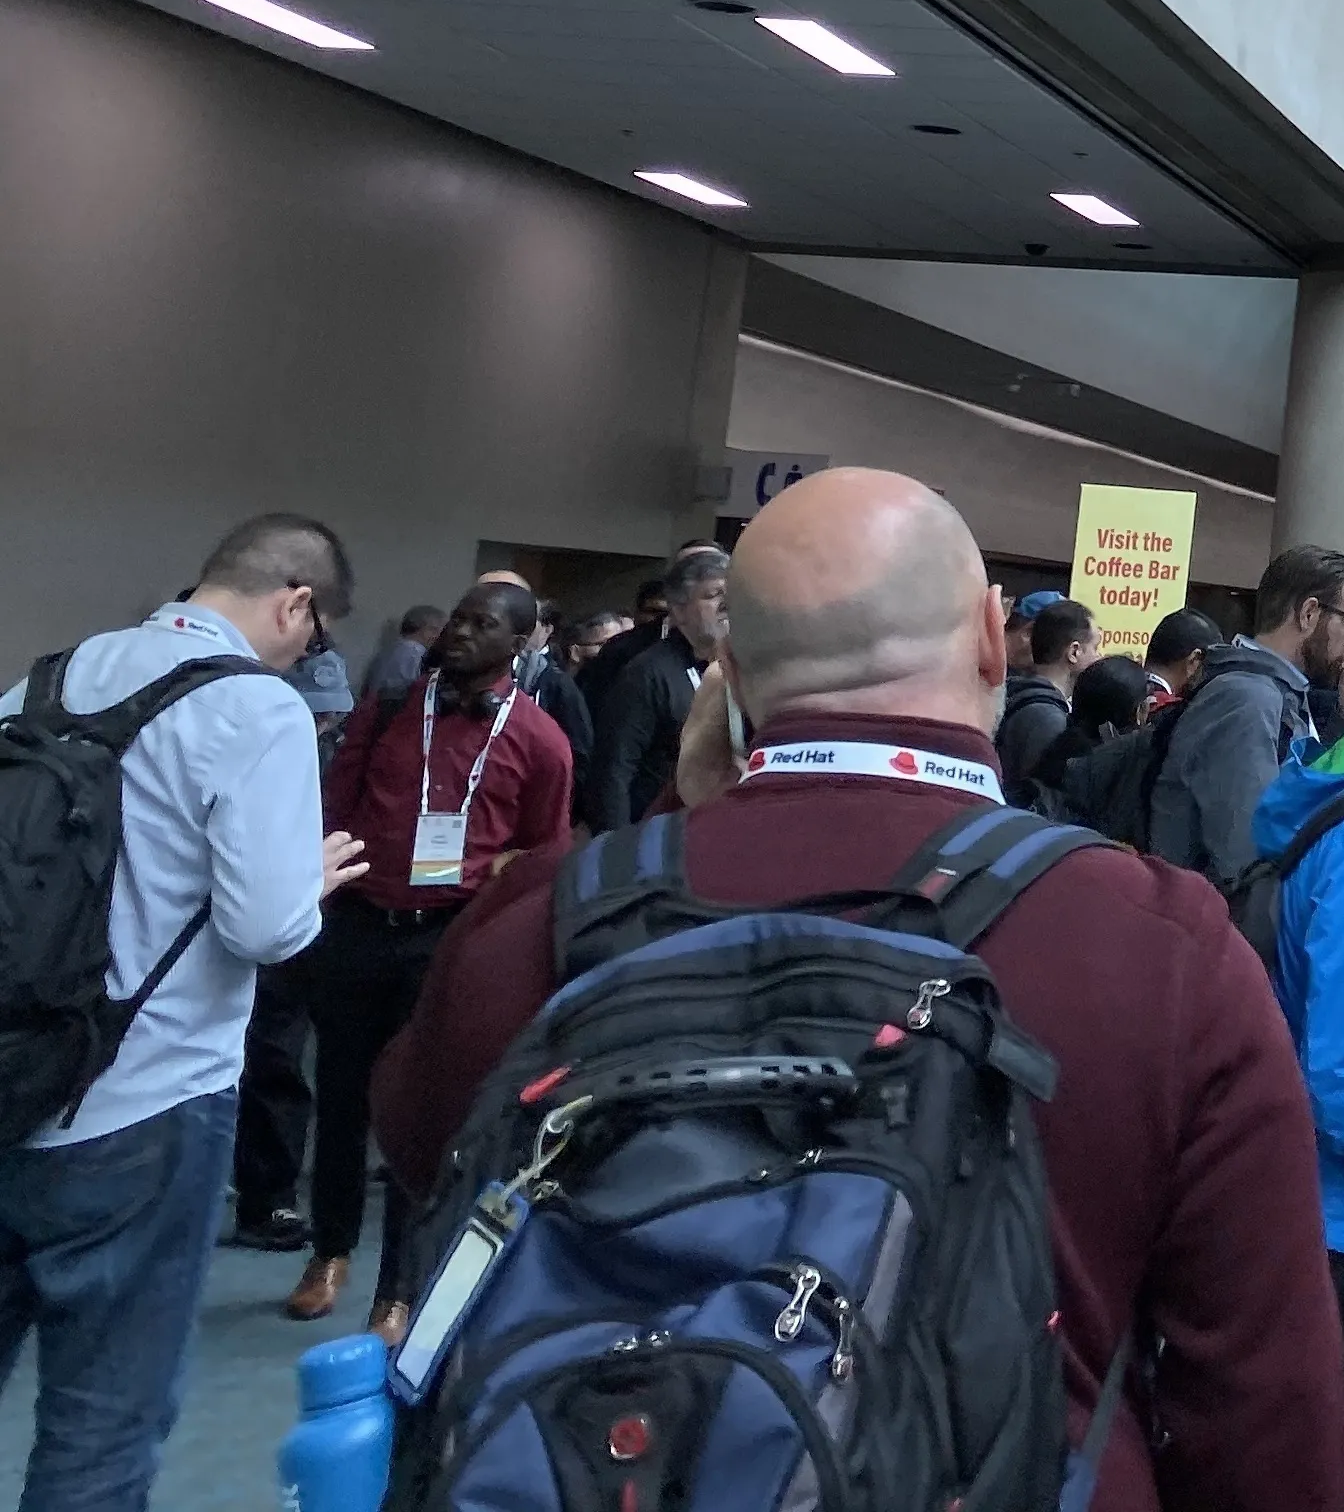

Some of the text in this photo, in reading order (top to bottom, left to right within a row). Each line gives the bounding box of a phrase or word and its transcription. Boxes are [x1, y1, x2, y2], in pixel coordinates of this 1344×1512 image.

[1097, 528, 1173, 553] Visit the
[1084, 556, 1181, 581] Coffee Bar
[1099, 585, 1159, 612] today!
[1099, 626, 1151, 649] ponso
[771, 749, 836, 764] Red Hat
[924, 760, 985, 787] Red Hat
